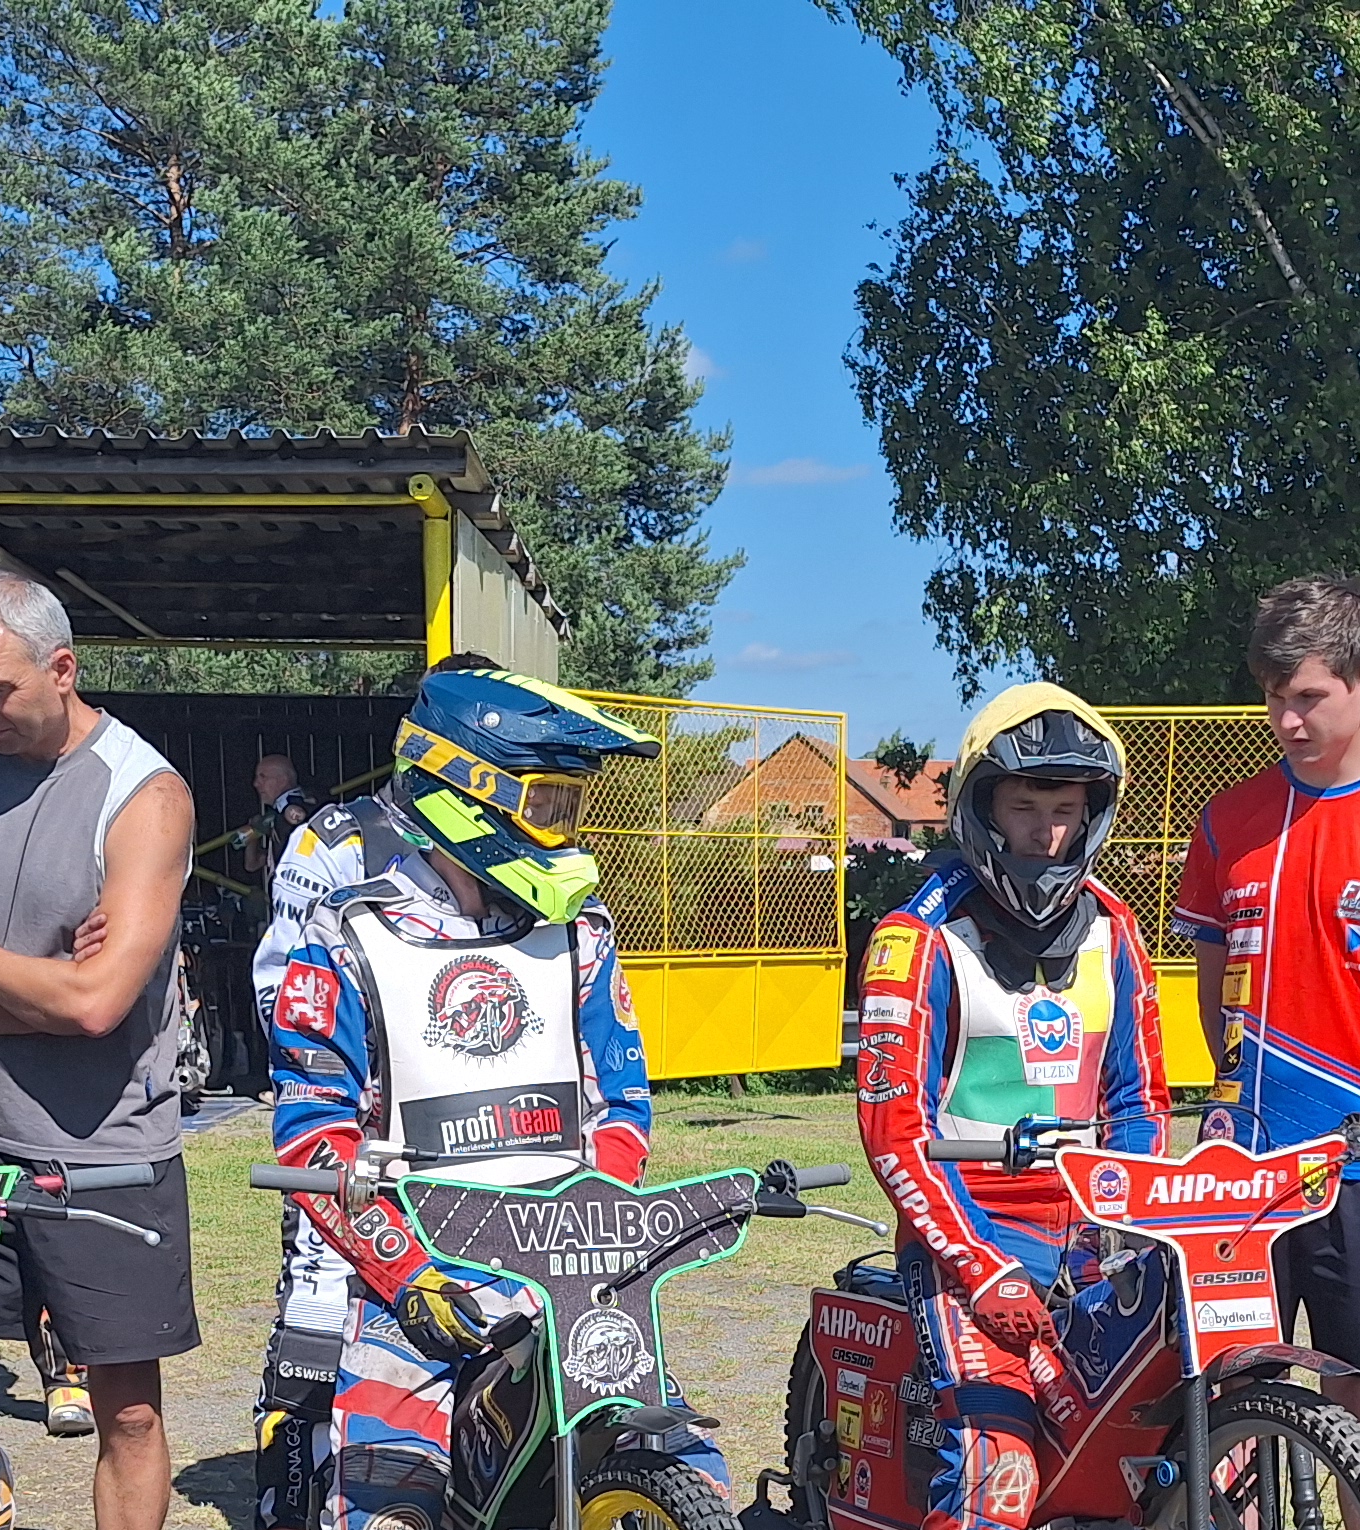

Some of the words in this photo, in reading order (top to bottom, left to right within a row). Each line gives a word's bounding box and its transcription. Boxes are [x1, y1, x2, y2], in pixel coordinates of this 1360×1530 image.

[441, 1104, 505, 1154] profil
[510, 1106, 563, 1136] team
[504, 1200, 684, 1252] WALBO
[1192, 1270, 1267, 1286] CASSIDA
[294, 1367, 337, 1384] SWISS
